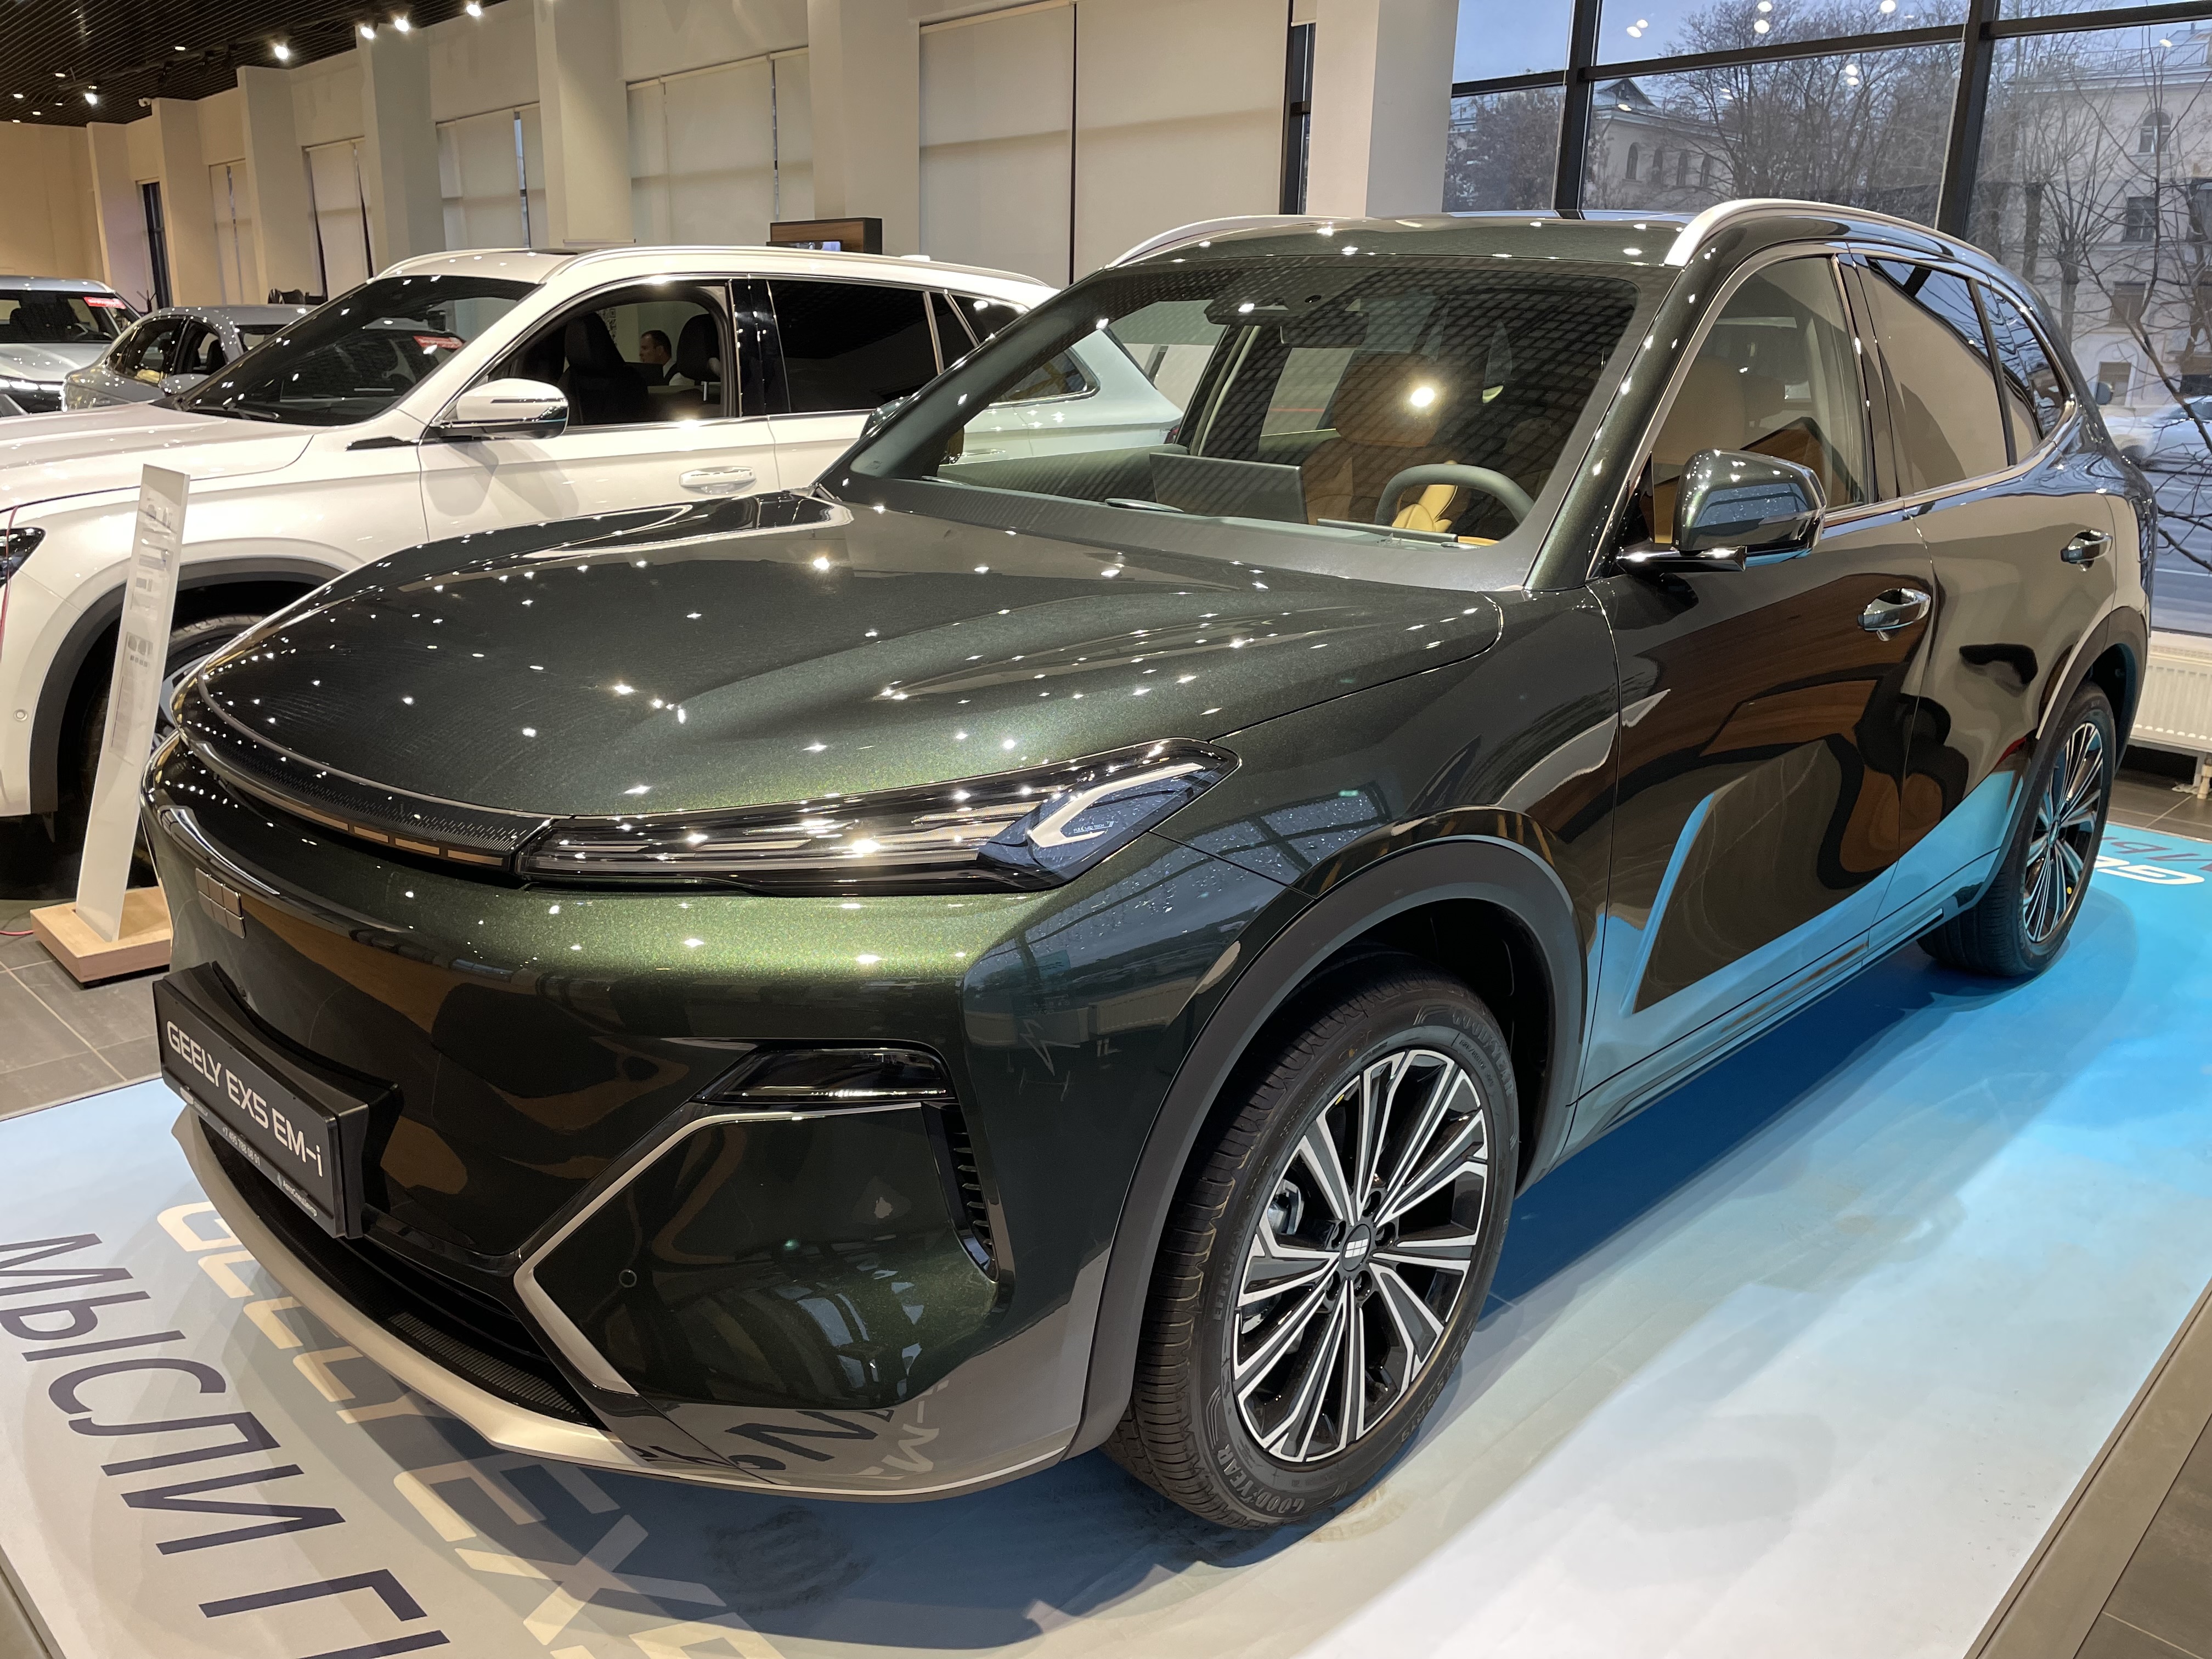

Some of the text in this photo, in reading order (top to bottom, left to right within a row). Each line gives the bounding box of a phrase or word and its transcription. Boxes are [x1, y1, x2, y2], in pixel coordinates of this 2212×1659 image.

[167, 1020, 323, 1177] GEELY EX5 EM-i
[254, 1153, 261, 1166] 01
[0, 1233, 451, 1659] МЫСЛИ Г
[1217, 1443, 1306, 1514] GOODYEAR
